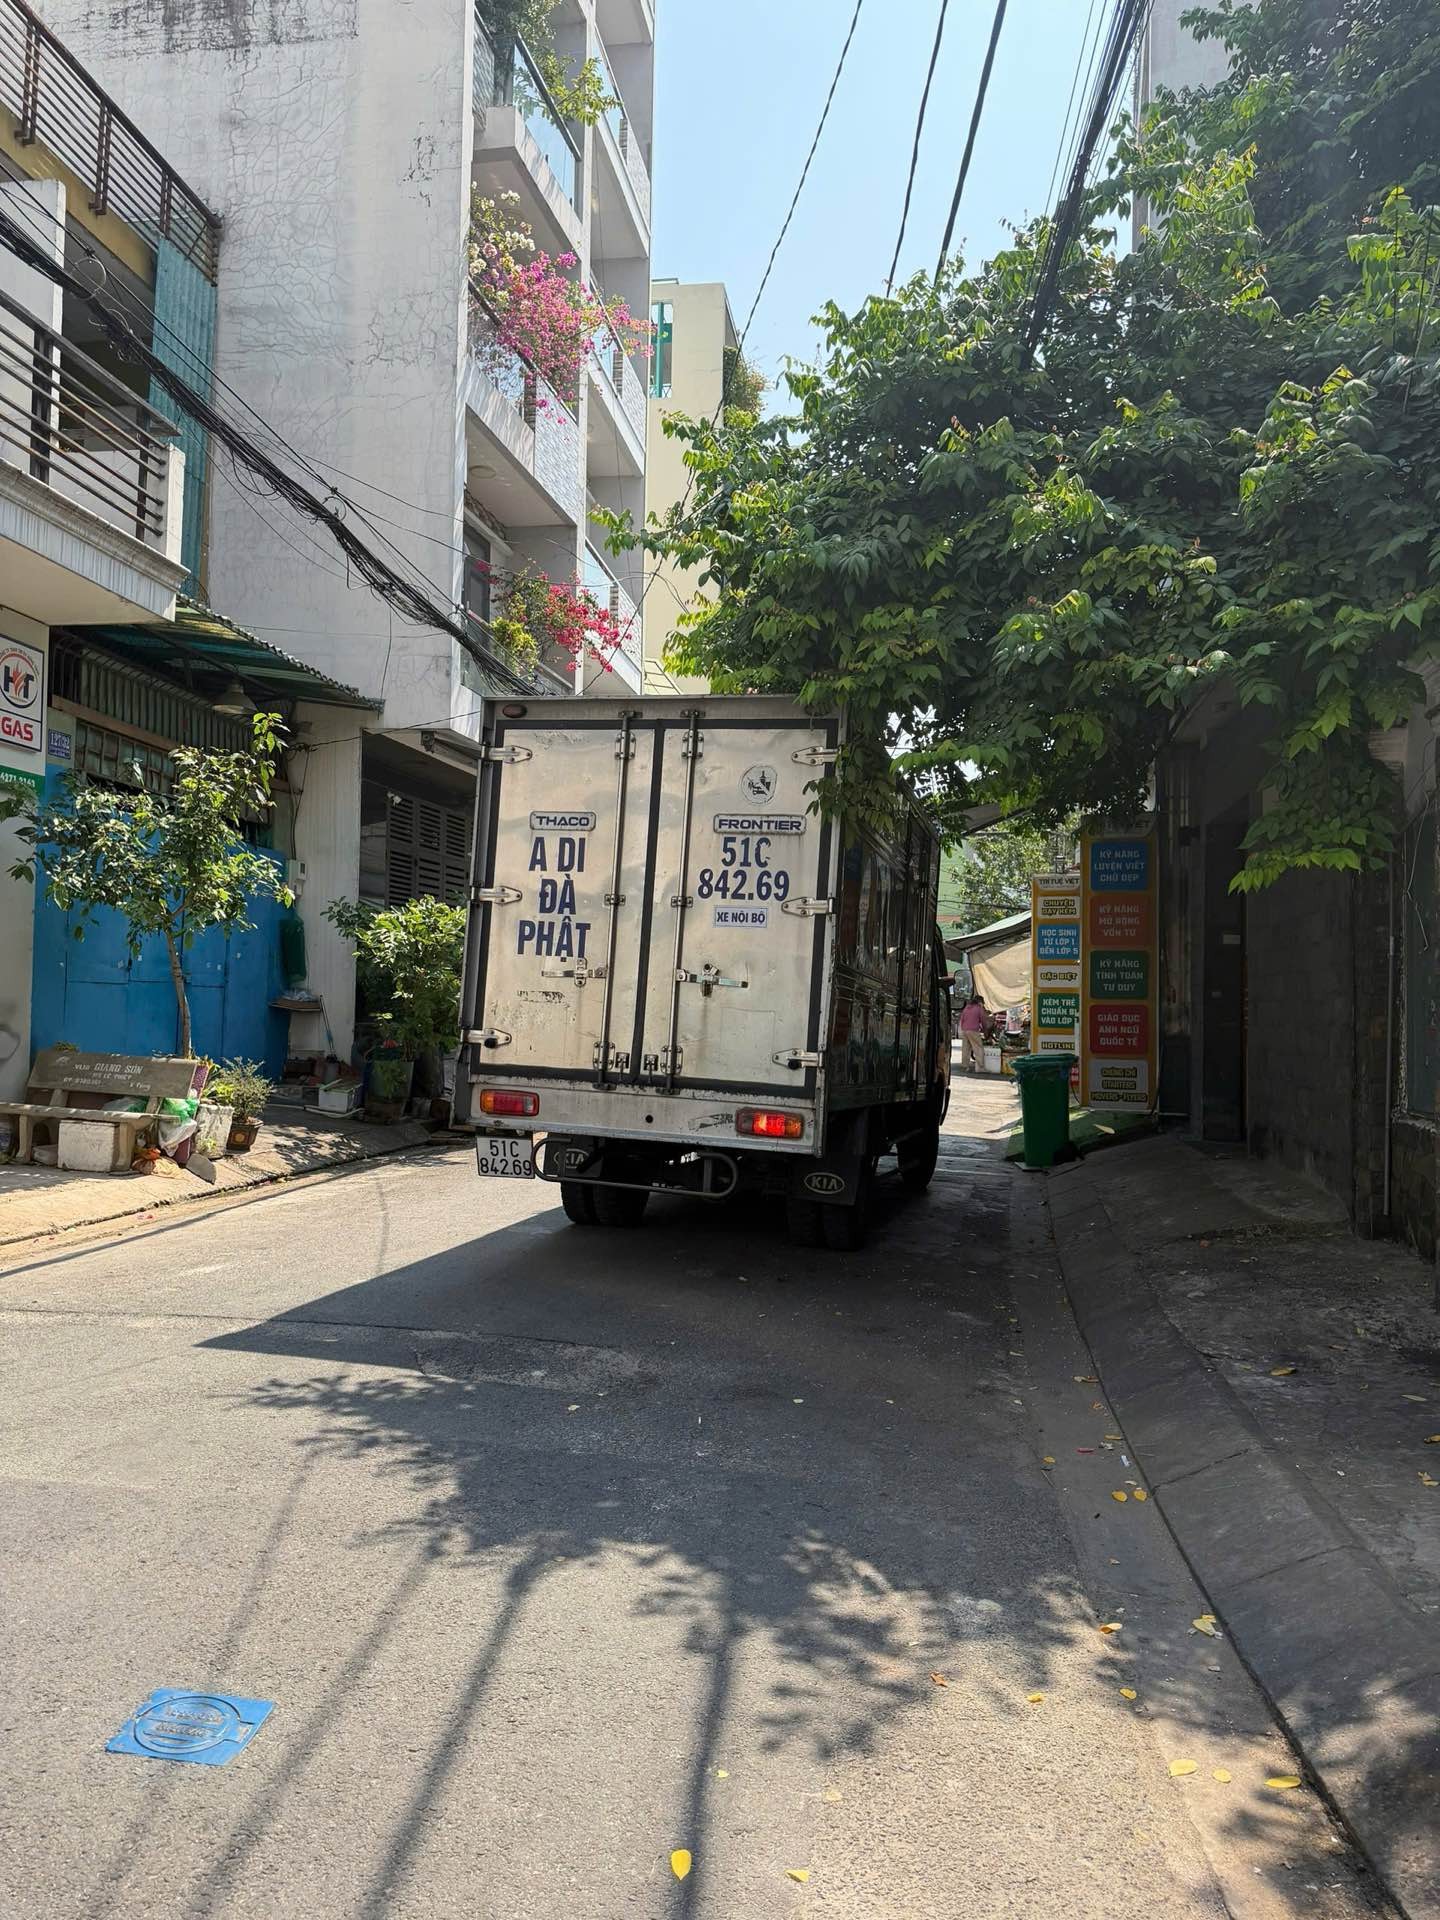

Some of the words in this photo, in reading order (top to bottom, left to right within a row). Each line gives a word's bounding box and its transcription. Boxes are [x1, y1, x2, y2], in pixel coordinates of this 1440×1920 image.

[1, 715, 34, 742] GAS
[535, 815, 590, 827] THACO
[718, 818, 802, 831] FRONTIER
[528, 836, 548, 872] A
[557, 837, 587, 873] DI
[721, 836, 772, 868] 51C
[539, 873, 577, 915] ĐÀ
[698, 868, 790, 901] 842.69
[716, 911, 729, 923] XE
[517, 915, 592, 963] PHẬT
[489, 1139, 519, 1158] 51C
[479, 1157, 532, 1176] 842.69
[810, 1175, 840, 1191] KIA
